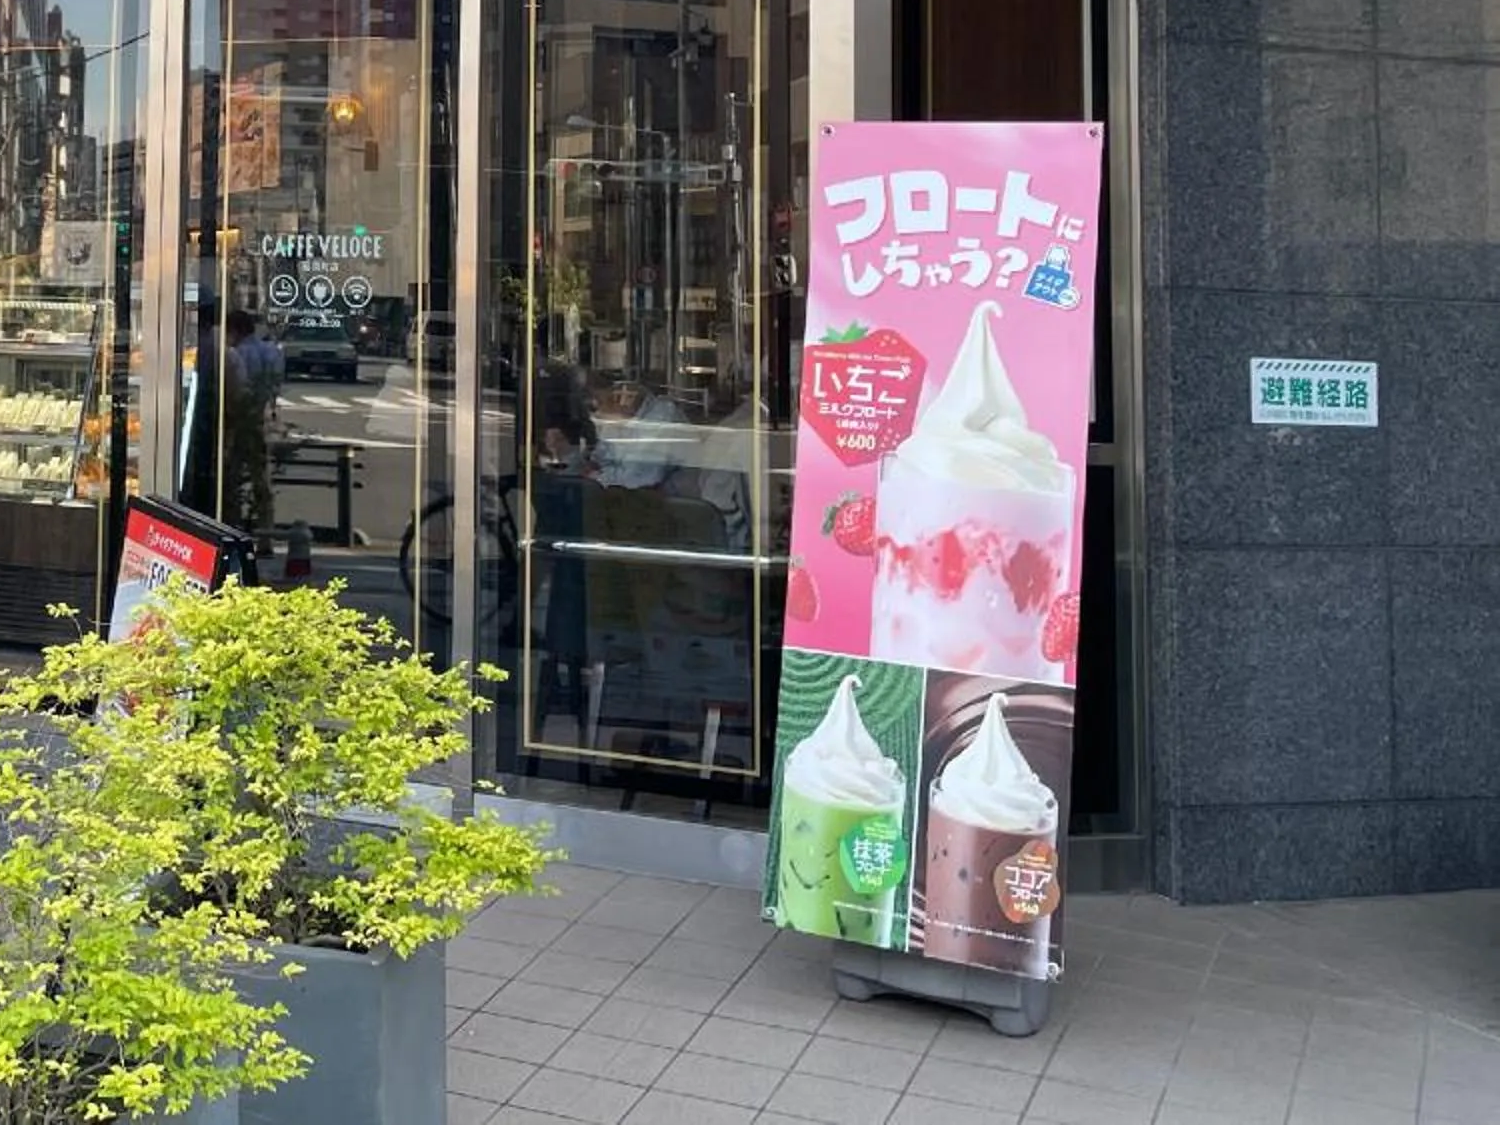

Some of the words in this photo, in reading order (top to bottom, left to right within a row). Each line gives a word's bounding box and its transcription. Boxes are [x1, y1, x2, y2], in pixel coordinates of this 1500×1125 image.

[823, 169, 1085, 245] フロートに
[318, 234, 383, 259] VELOCE
[812, 362, 913, 404] いちご
[1260, 376, 1369, 409] 避難経路
[818, 402, 900, 421] ミルクフロート
[836, 432, 877, 451] ¥600
[1003, 865, 1053, 890] ココア
